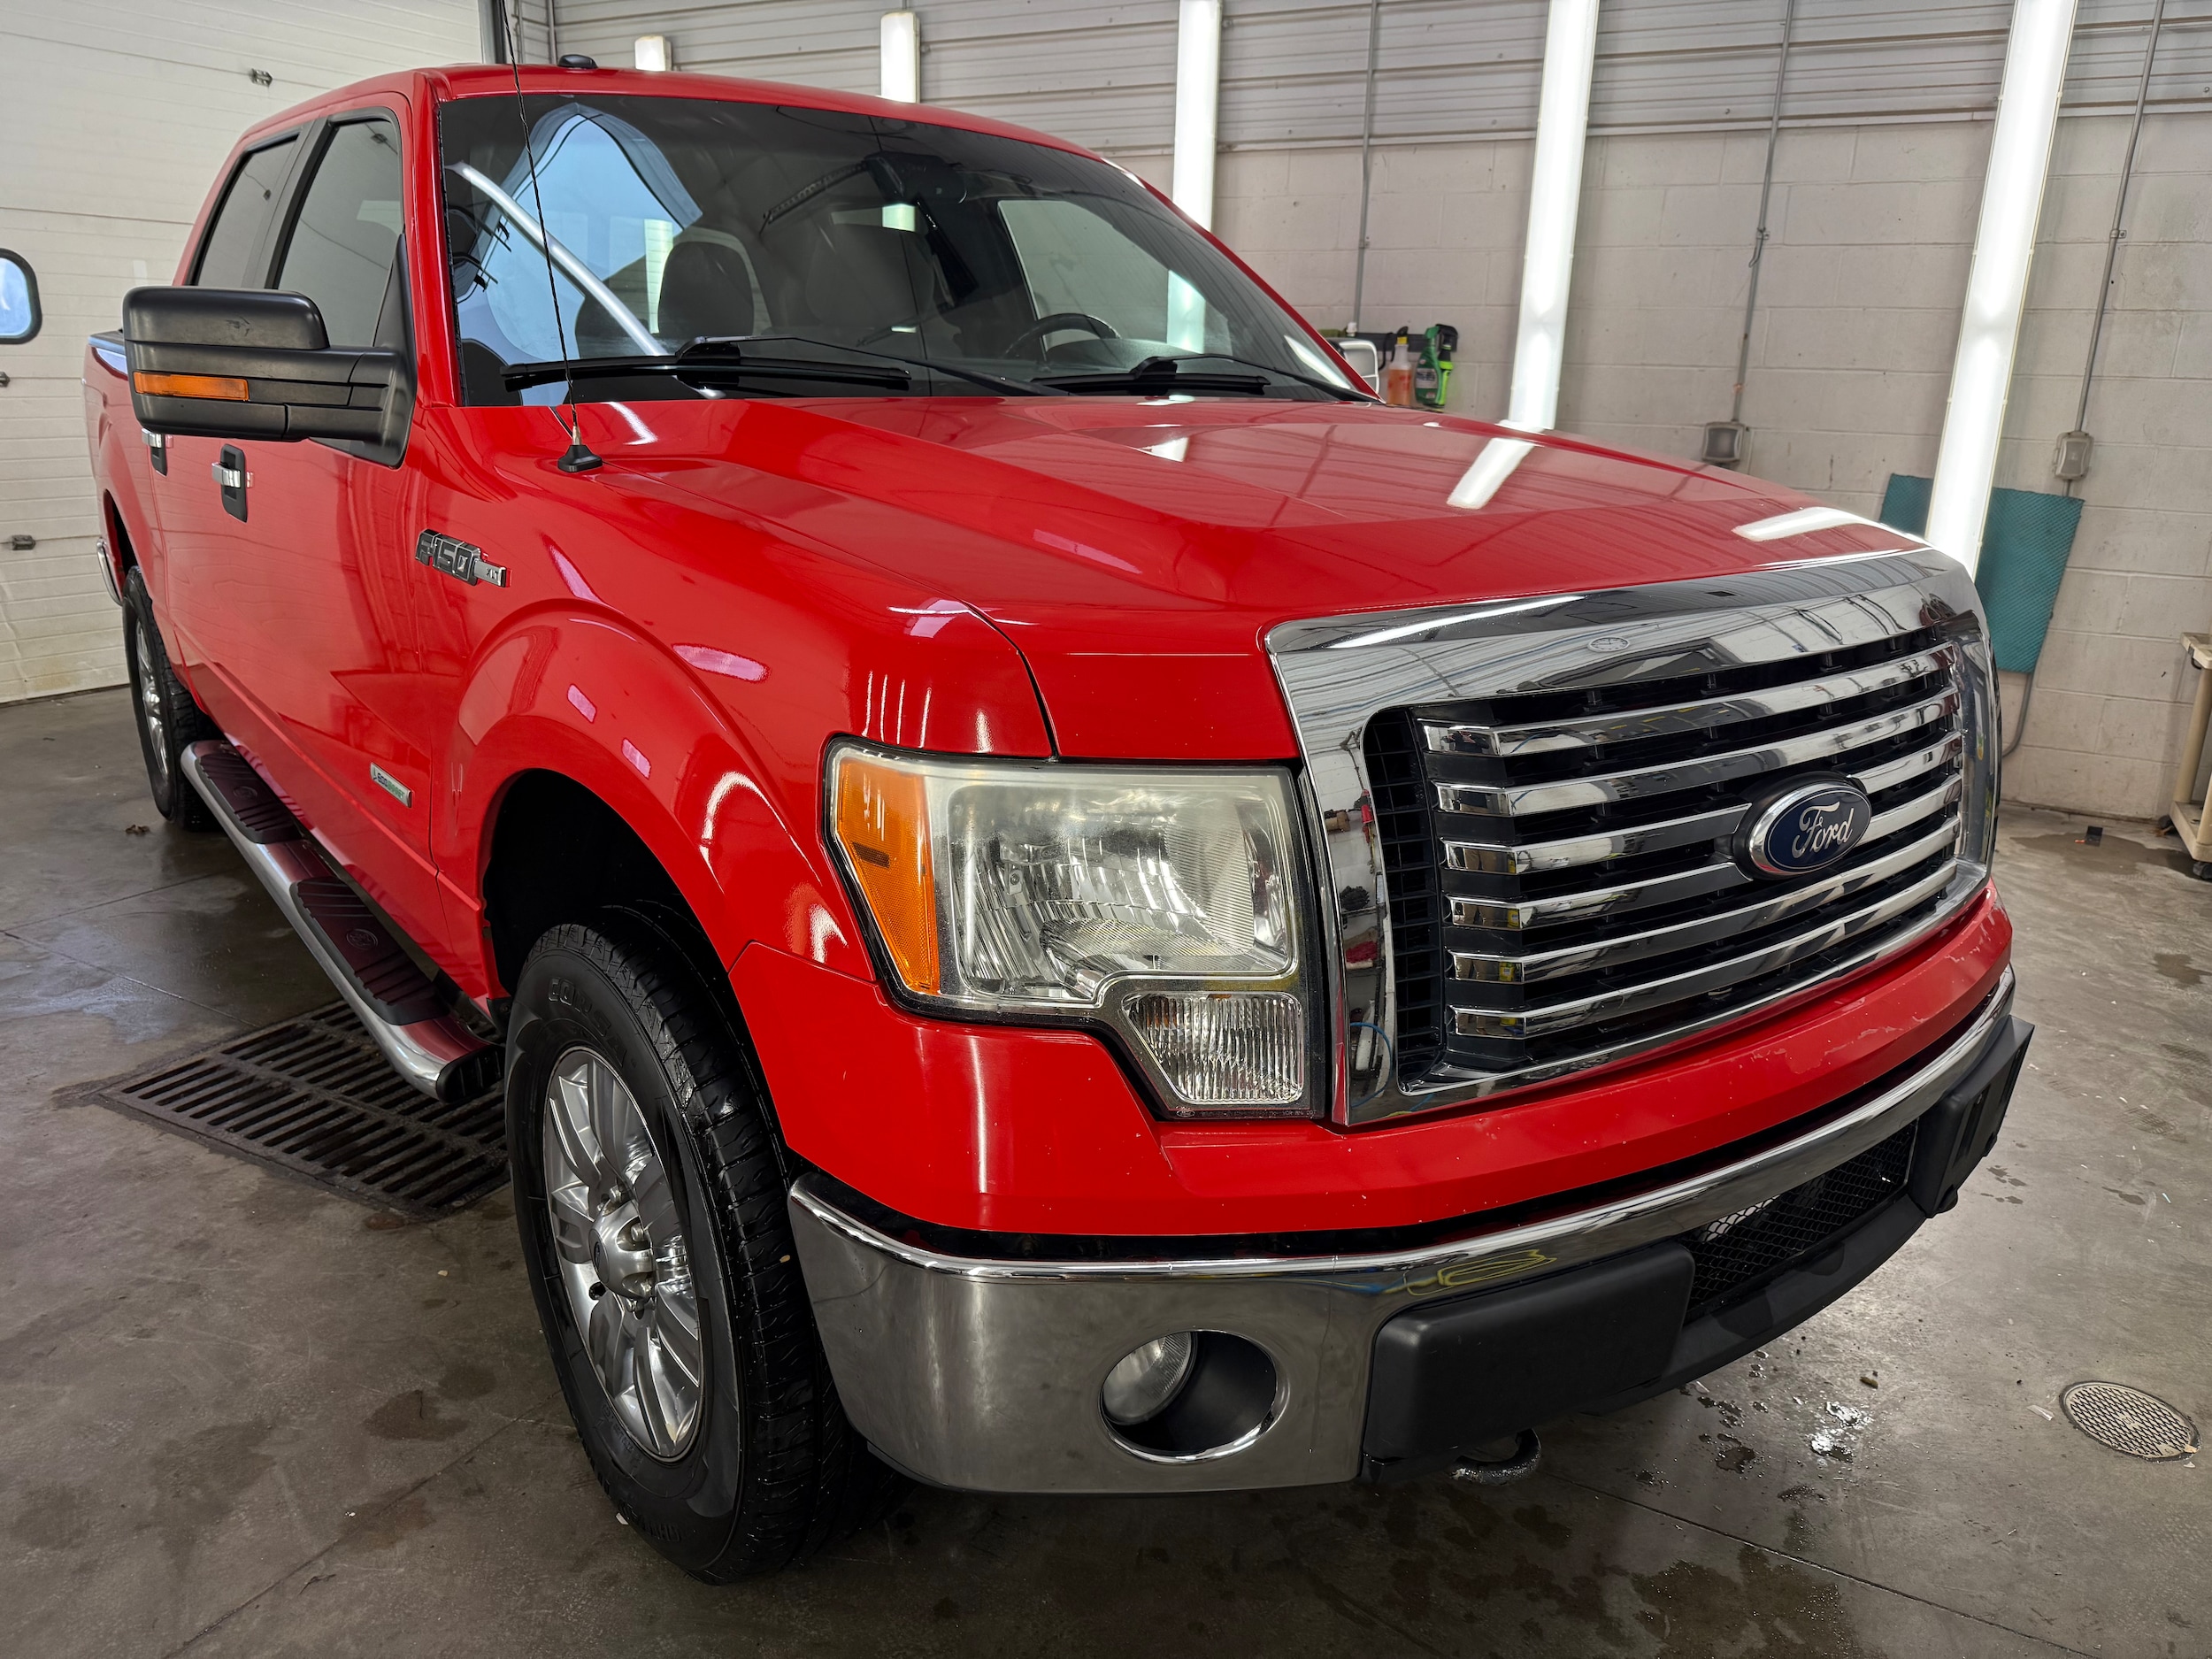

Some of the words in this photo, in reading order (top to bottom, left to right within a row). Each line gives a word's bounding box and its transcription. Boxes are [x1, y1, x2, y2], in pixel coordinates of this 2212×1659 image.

[486, 566, 498, 580] XLT
[1791, 801, 1855, 858] Ford
[548, 977, 627, 1067] CORSA
